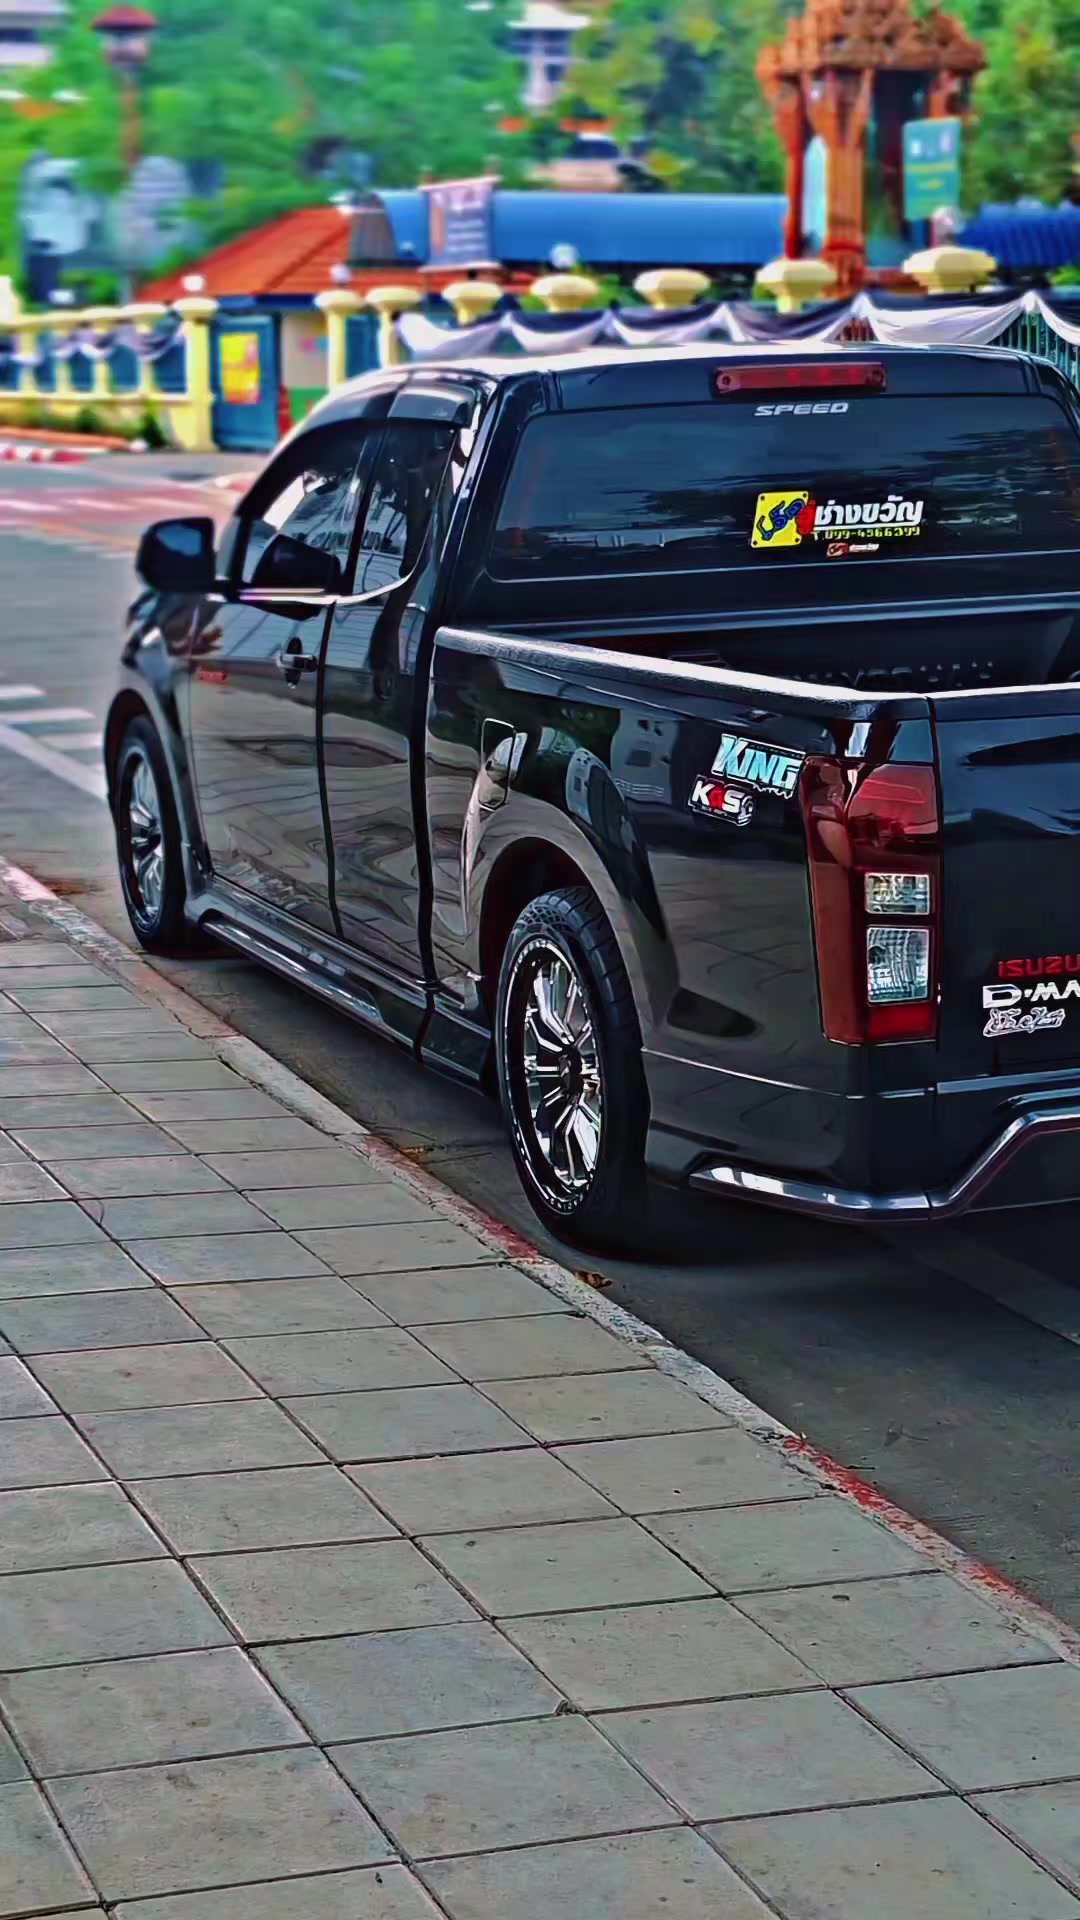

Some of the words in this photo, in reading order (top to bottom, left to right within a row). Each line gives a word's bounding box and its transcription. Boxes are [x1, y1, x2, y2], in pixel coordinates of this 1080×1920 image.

[754, 402, 848, 416] SPEED
[711, 733, 803, 790] KING
[998, 953, 1080, 977] ISUZU
